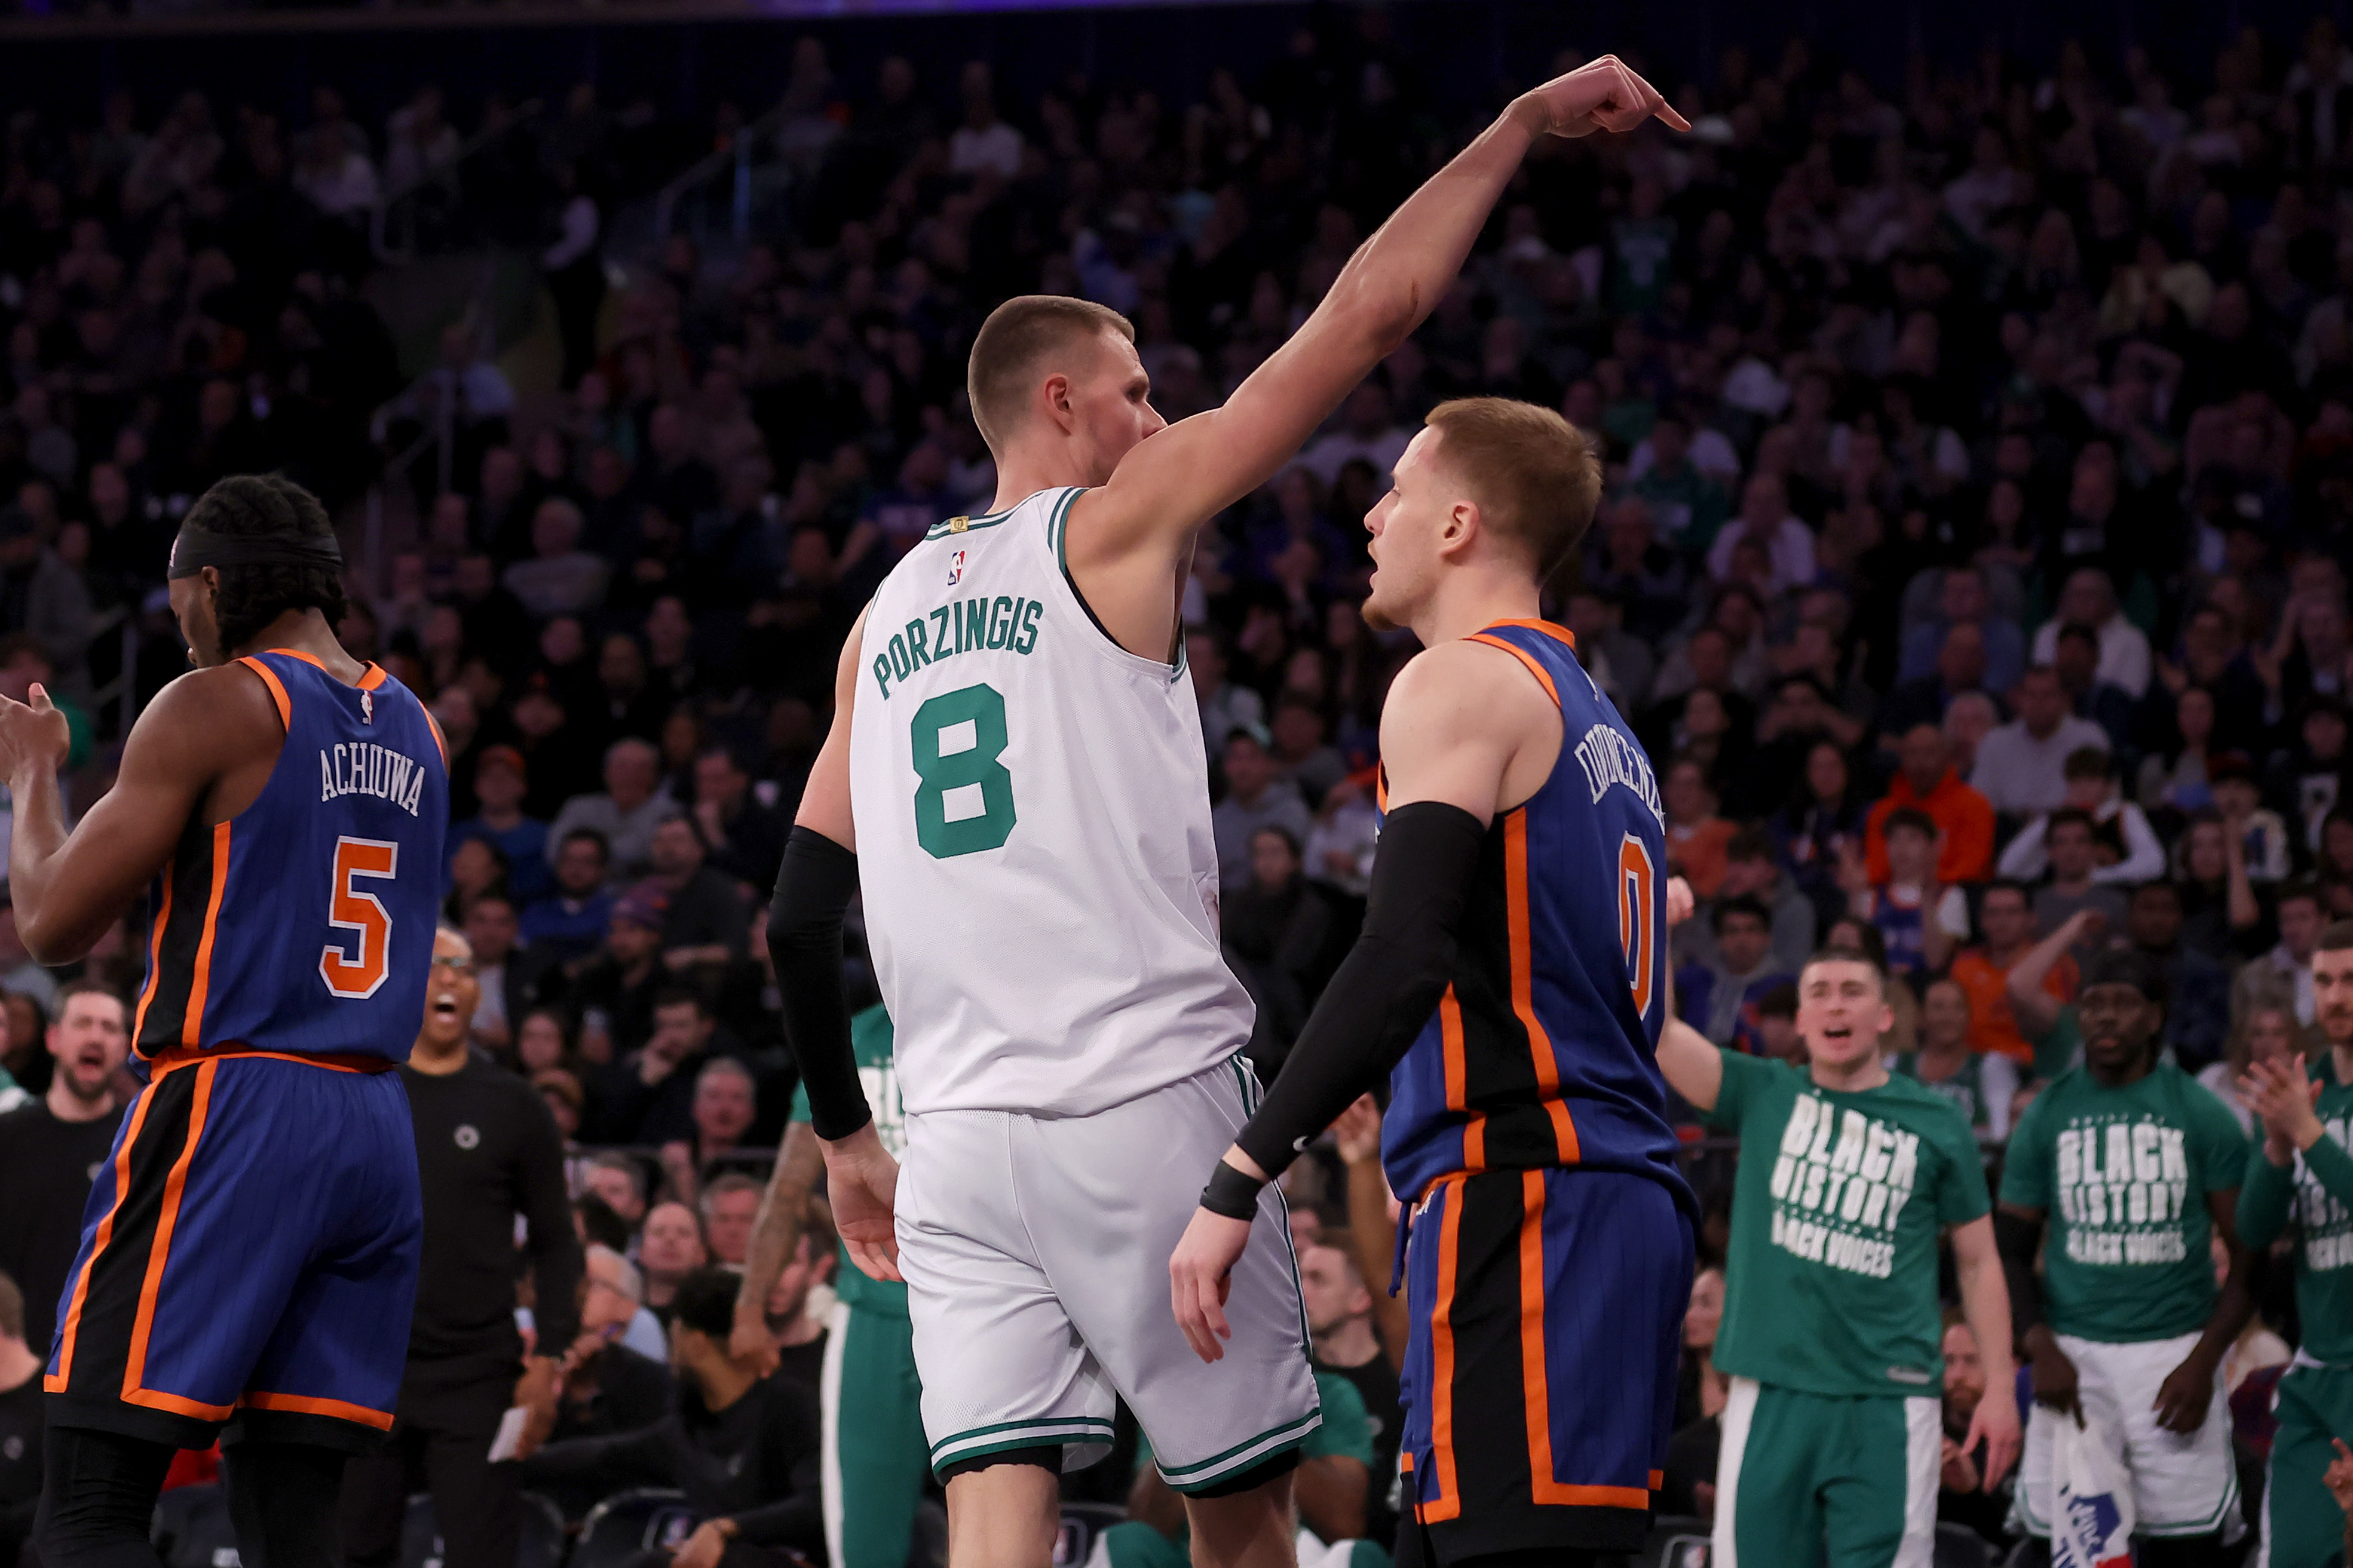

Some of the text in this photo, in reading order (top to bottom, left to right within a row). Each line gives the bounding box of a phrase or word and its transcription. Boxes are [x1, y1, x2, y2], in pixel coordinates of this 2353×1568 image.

[873, 596, 1043, 701] PORZINGIS
[320, 742, 426, 817] ACHIUWA
[911, 683, 1016, 859] 8
[318, 834, 399, 999] 5
[1619, 830, 1655, 1021] 0
[1779, 1092, 1920, 1191] BLACK
[2057, 1121, 2189, 1186] BLACK
